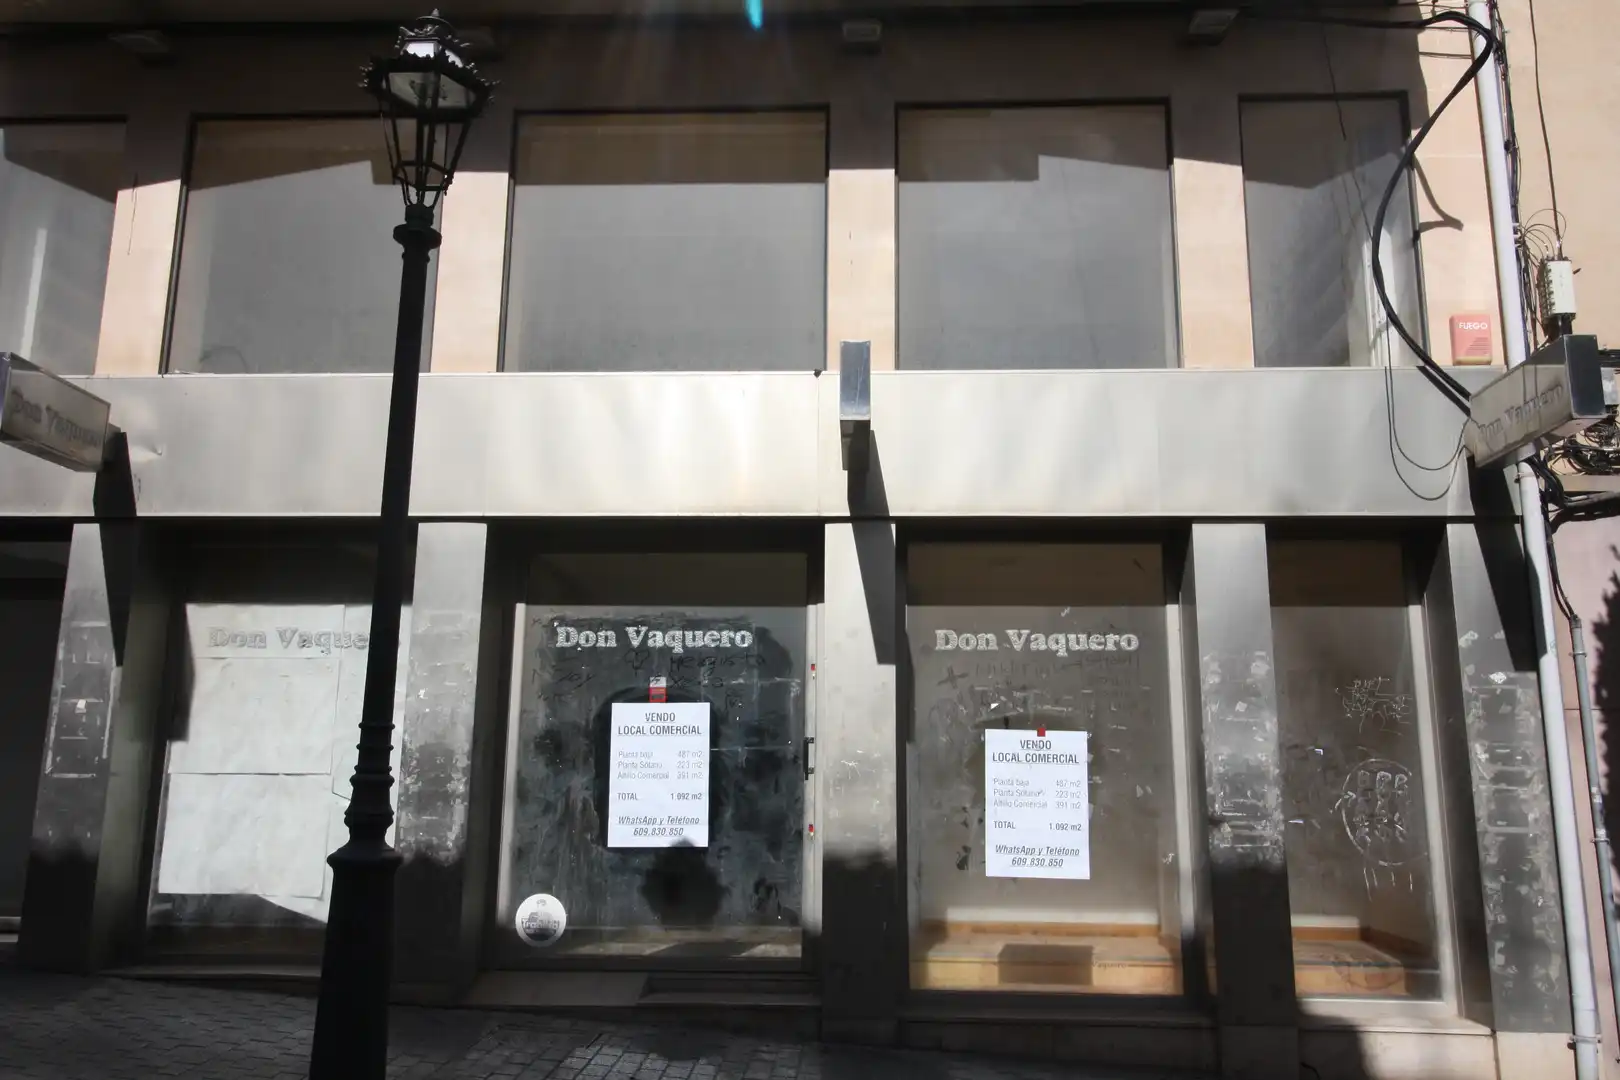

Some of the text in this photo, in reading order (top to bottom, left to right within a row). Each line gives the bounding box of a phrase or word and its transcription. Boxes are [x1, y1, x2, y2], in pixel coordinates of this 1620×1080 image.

[1458, 321, 1488, 330] FUEGO
[206, 626, 369, 655] Don Vaque
[555, 625, 753, 653] Don Vaquero
[934, 629, 1139, 657] Don Vaquero
[645, 712, 676, 722] VENDO
[618, 725, 702, 735] LOCAL COMERCIAL
[1020, 739, 1052, 750] VENDO
[992, 752, 1079, 764] LOCAL COMERCIAL
[618, 761, 638, 769] Planta
[993, 777, 1014, 786] Planta
[617, 792, 639, 801] TOTAL
[691, 792, 703, 800] m2
[993, 789, 1014, 797] Planta
[1013, 800, 1048, 809] Comercial
[1055, 802, 1068, 810] 391
[618, 815, 657, 826] WhatsApp
[667, 816, 700, 825] Teléfono
[993, 820, 1082, 831] TOTAL 1.092 m2
[633, 827, 684, 837] 609.830.850
[995, 844, 1036, 856] WhatsApp
[1045, 846, 1080, 856] Teléfono
[1011, 857, 1064, 867] 609.830.850
